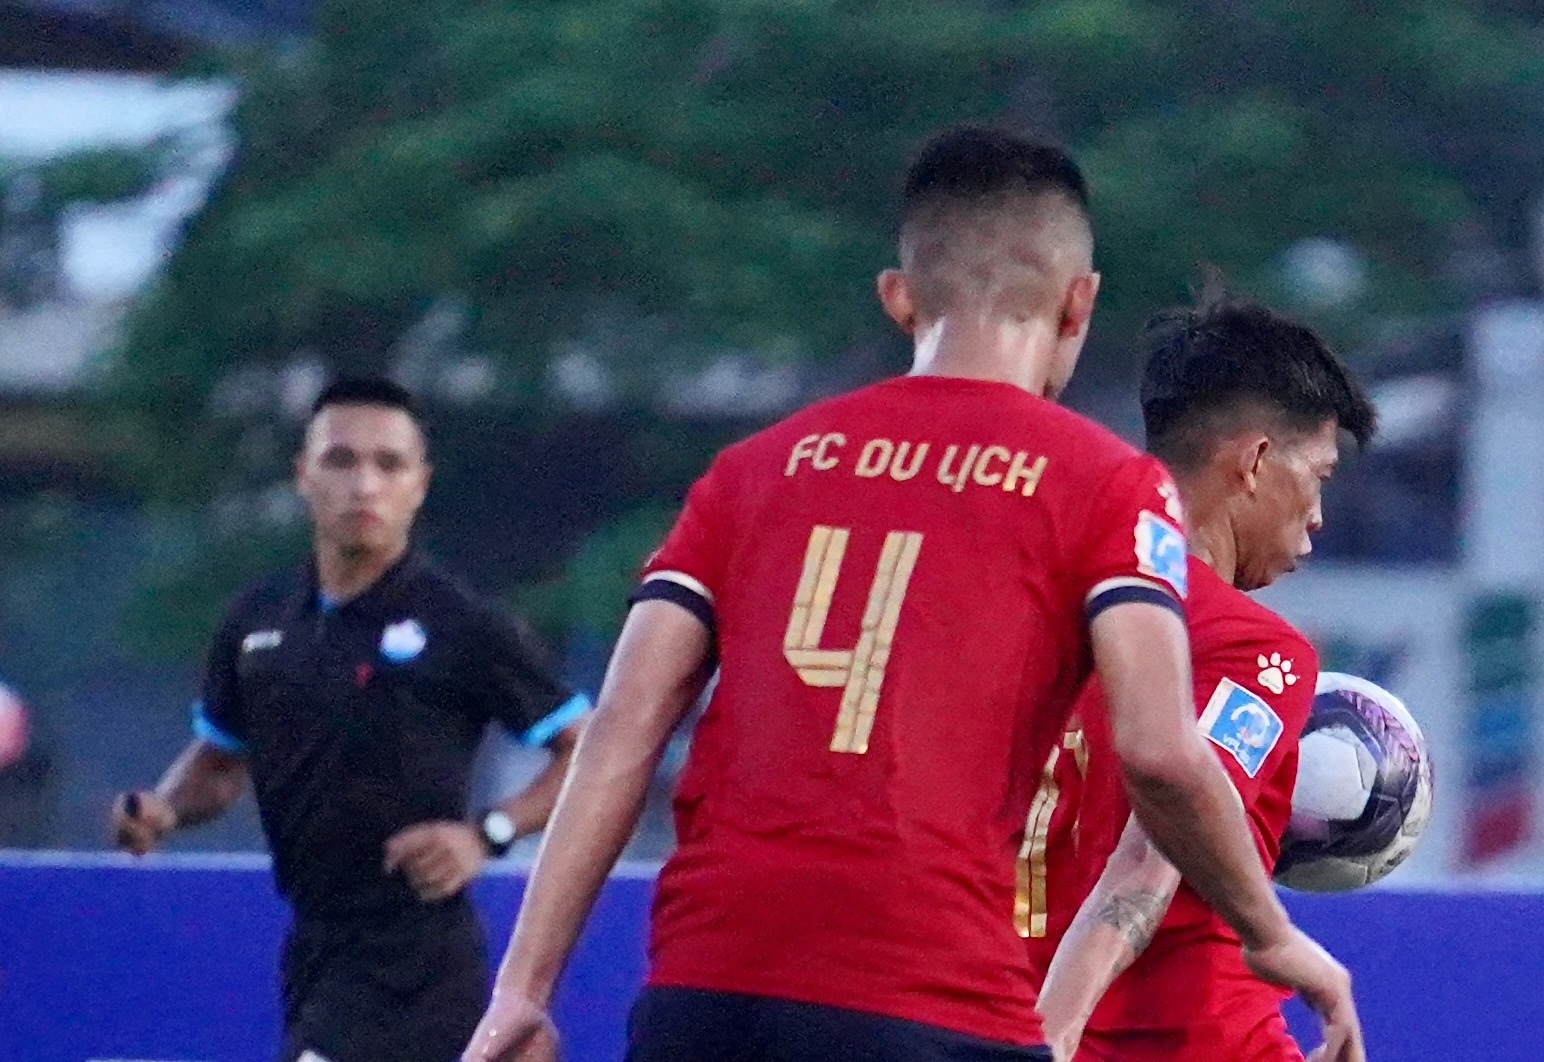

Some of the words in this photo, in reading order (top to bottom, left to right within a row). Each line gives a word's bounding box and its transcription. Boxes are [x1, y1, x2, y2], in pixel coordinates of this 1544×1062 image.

[784, 432, 847, 477] FC
[854, 438, 931, 481] DU
[783, 524, 925, 755] 4
